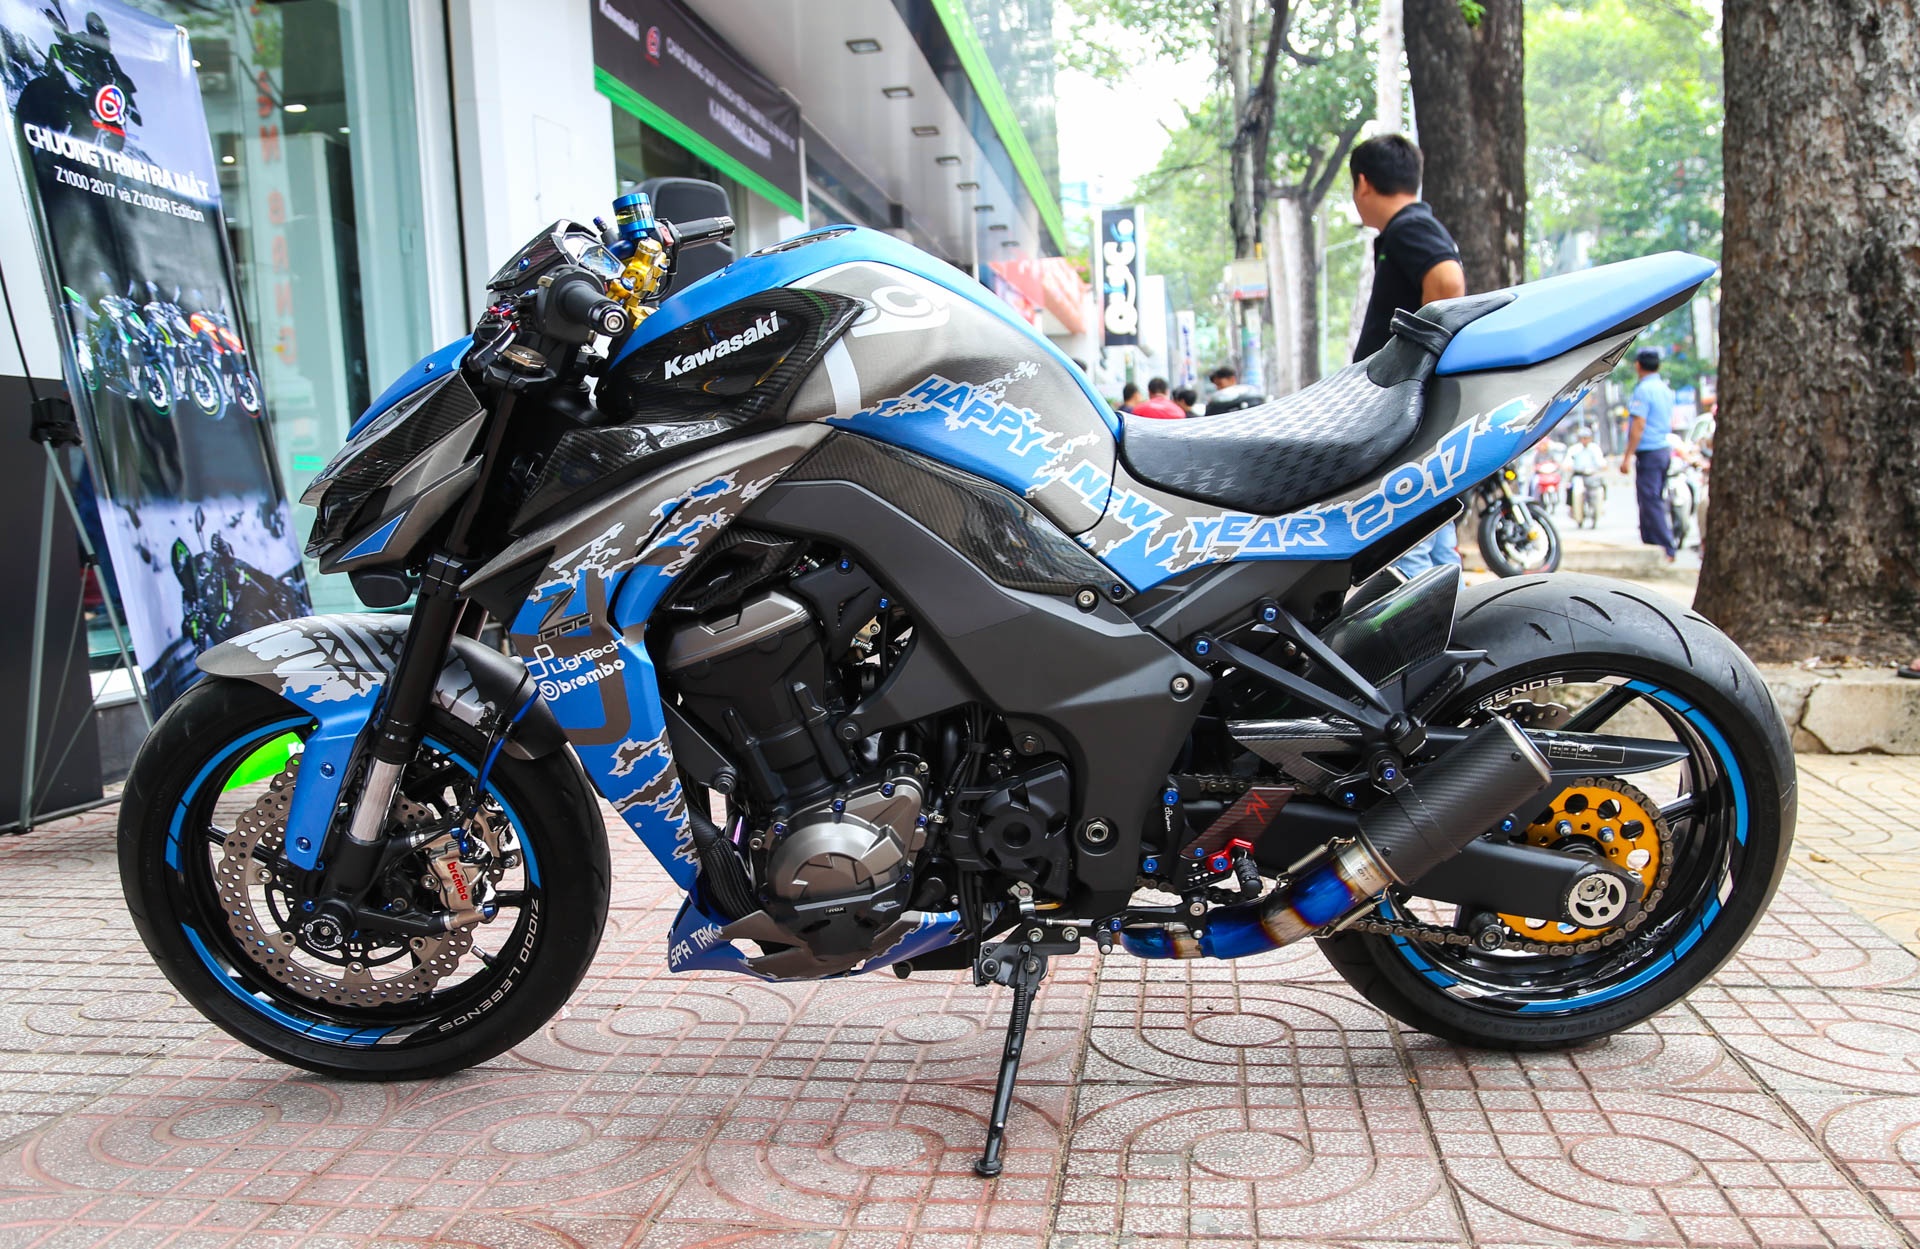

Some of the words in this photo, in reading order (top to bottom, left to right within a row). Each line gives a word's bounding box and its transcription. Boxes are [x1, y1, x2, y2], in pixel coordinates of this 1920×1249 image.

[54, 165, 91, 191] Z1000
[90, 178, 116, 198] 2017
[131, 189, 171, 214] Z1000R
[171, 203, 205, 222] Edition
[149, 163, 176, 191] RA
[663, 310, 780, 380] Kawasaki
[905, 373, 1053, 457] HAPPY
[1059, 458, 1174, 532] NEW
[1186, 511, 1328, 552] YEAR
[1349, 413, 1480, 541] 2017
[557, 658, 627, 694] brembo
[447, 861, 469, 901] brembo
[519, 897, 540, 964] Z1000
[670, 940, 693, 968] SPA
[438, 966, 521, 1033] LEGENDS
